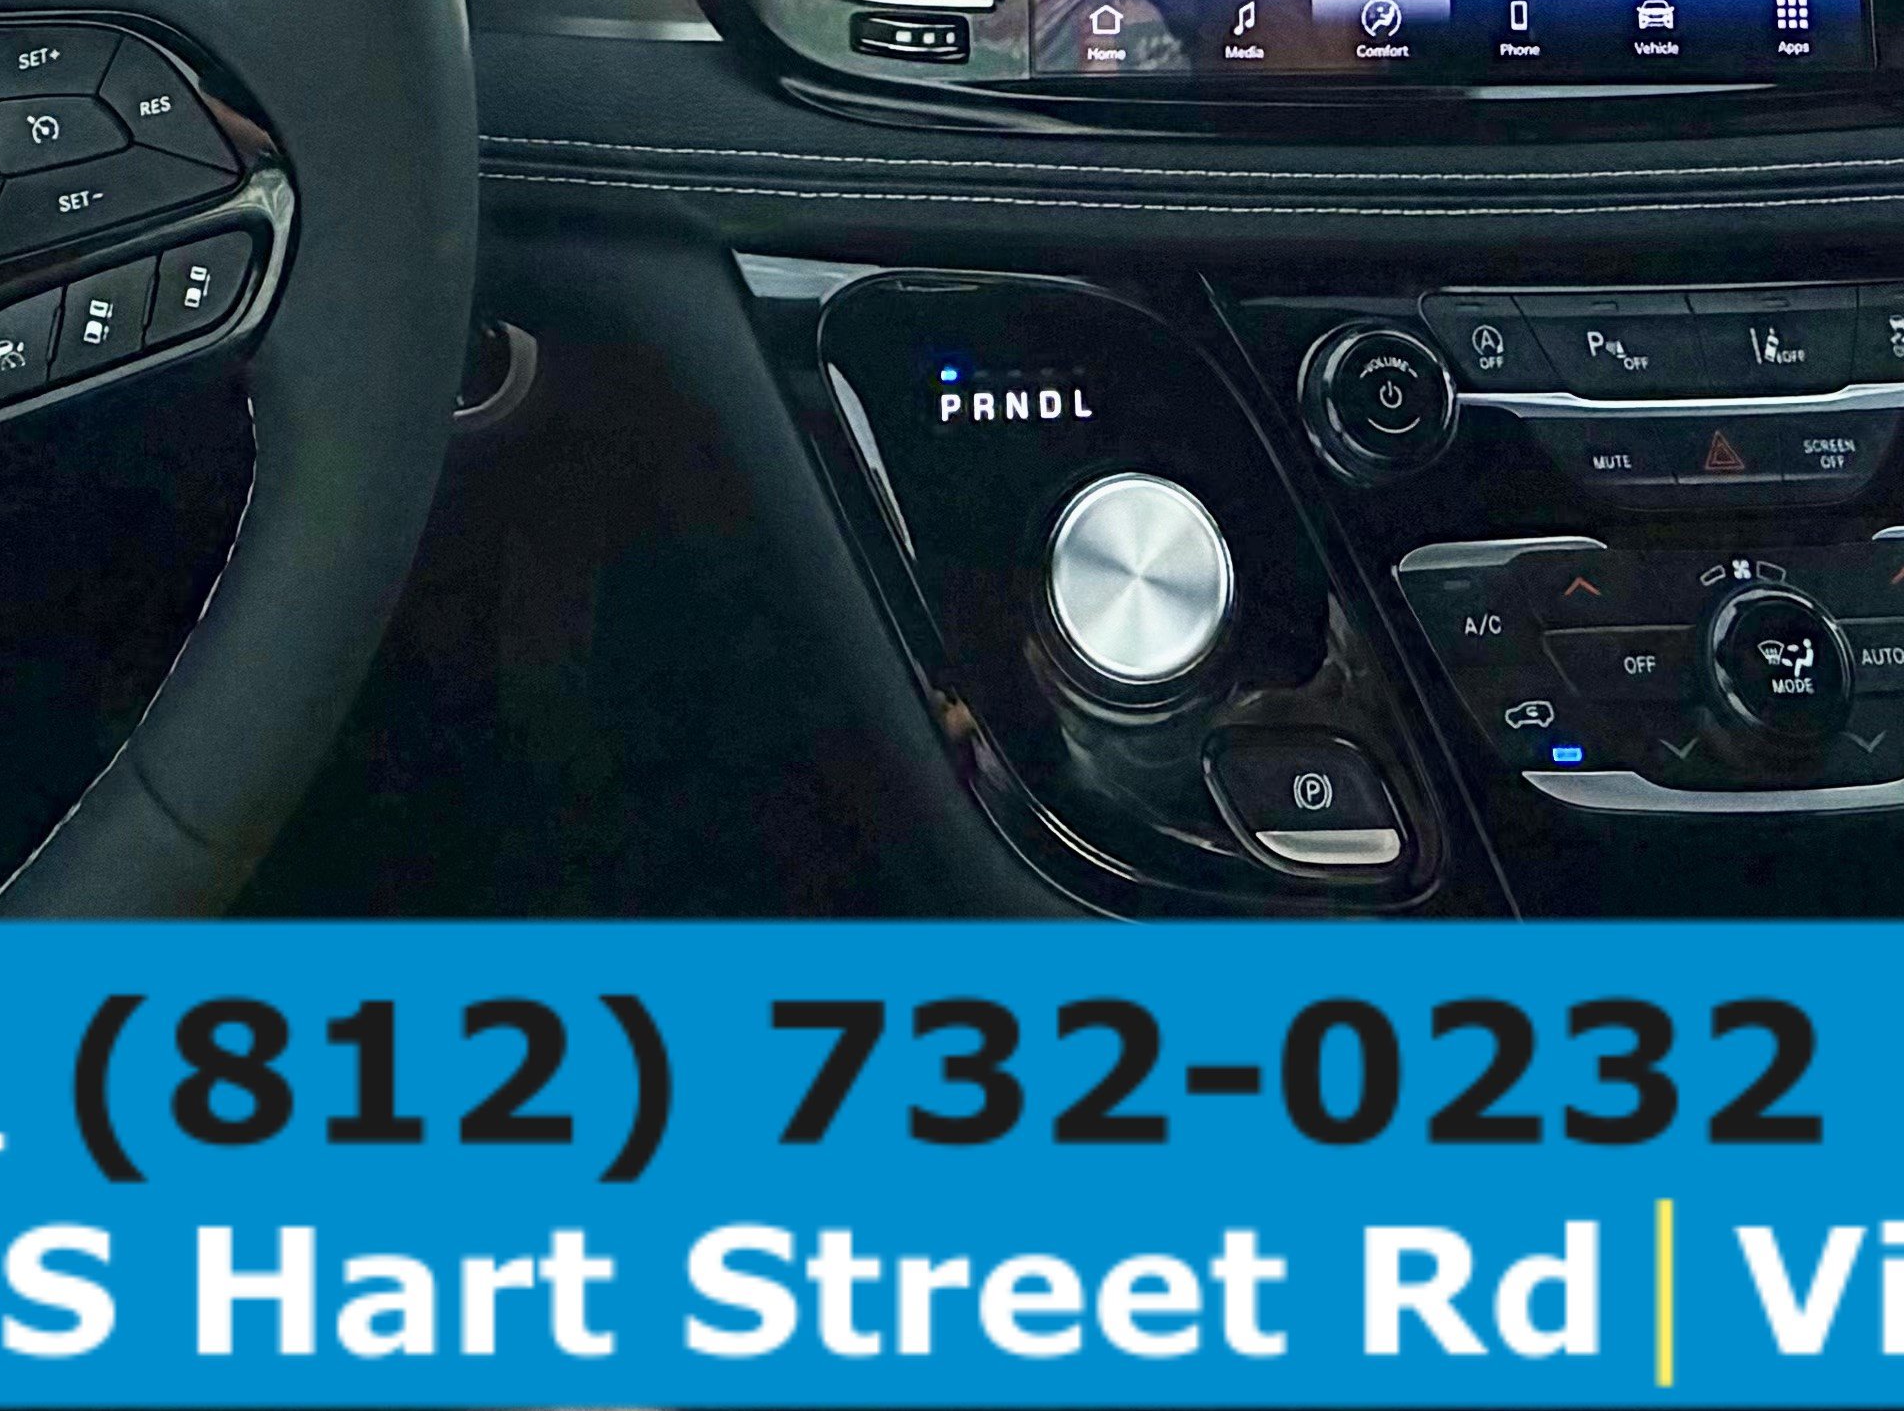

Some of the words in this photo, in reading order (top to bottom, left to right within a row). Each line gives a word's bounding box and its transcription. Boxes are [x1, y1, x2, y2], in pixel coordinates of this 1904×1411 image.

[1087, 47, 1127, 61] Home
[1225, 45, 1265, 59] Media
[1356, 44, 1410, 58] Comfort
[1499, 43, 1541, 56] Phone
[1634, 41, 1679, 55] Vehicle
[1777, 40, 1810, 56] Apps
[139, 96, 171, 116] RES
[1479, 356, 1503, 370] OFF
[1621, 354, 1648, 370] OFF
[1803, 438, 1856, 454] SCREEN
[1593, 454, 1632, 470] MUTE
[1820, 455, 1844, 469] OFF
[1464, 614, 1502, 636] A/C
[1623, 655, 1656, 675] OFF
[1771, 677, 1814, 694] MODE
